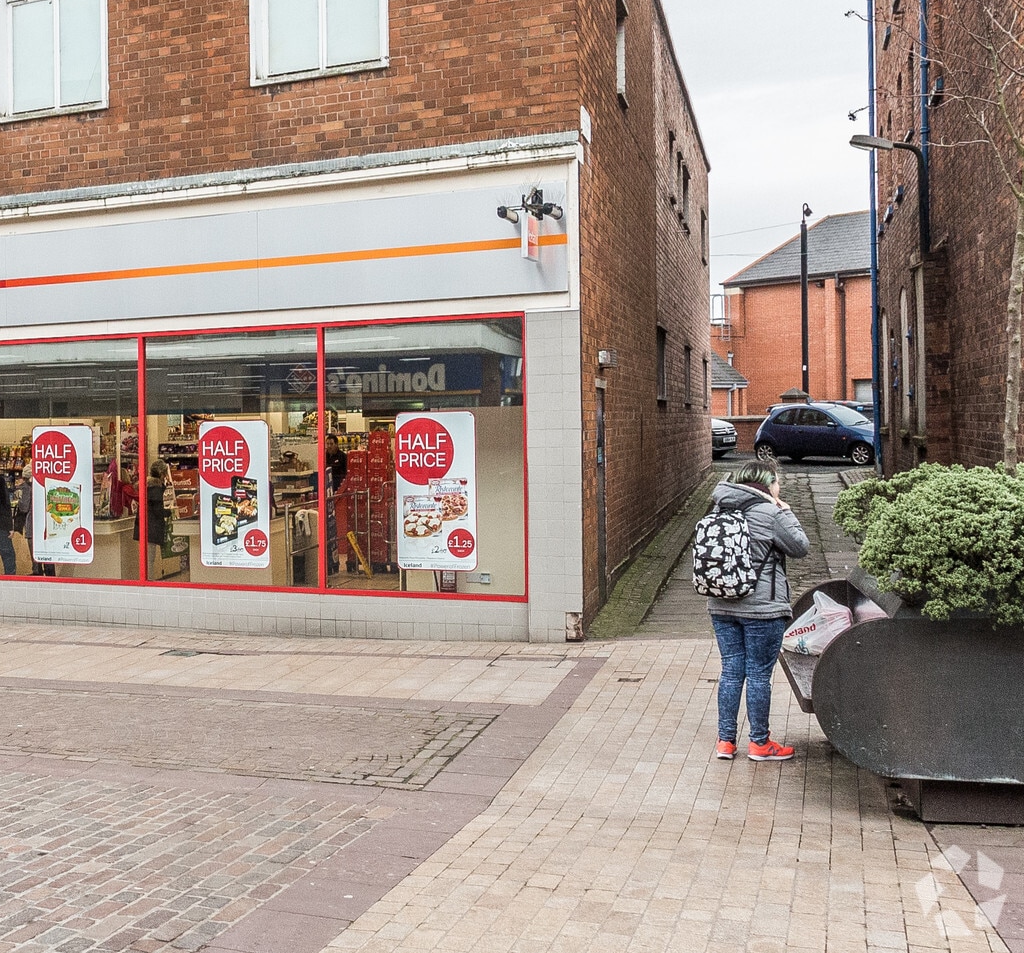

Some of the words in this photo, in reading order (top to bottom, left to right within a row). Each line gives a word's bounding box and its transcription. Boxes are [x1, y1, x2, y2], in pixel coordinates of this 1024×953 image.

[202, 440, 244, 456] HALF
[398, 433, 447, 450] HALF
[35, 444, 72, 458] HALF
[202, 458, 243, 472] PRICE
[399, 452, 446, 468] PRICE
[35, 461, 71, 474] PRICE
[75, 534, 87, 546] £1
[245, 535, 266, 548] £1.75
[448, 536, 473, 548] £1.25
[784, 623, 817, 639] eland
